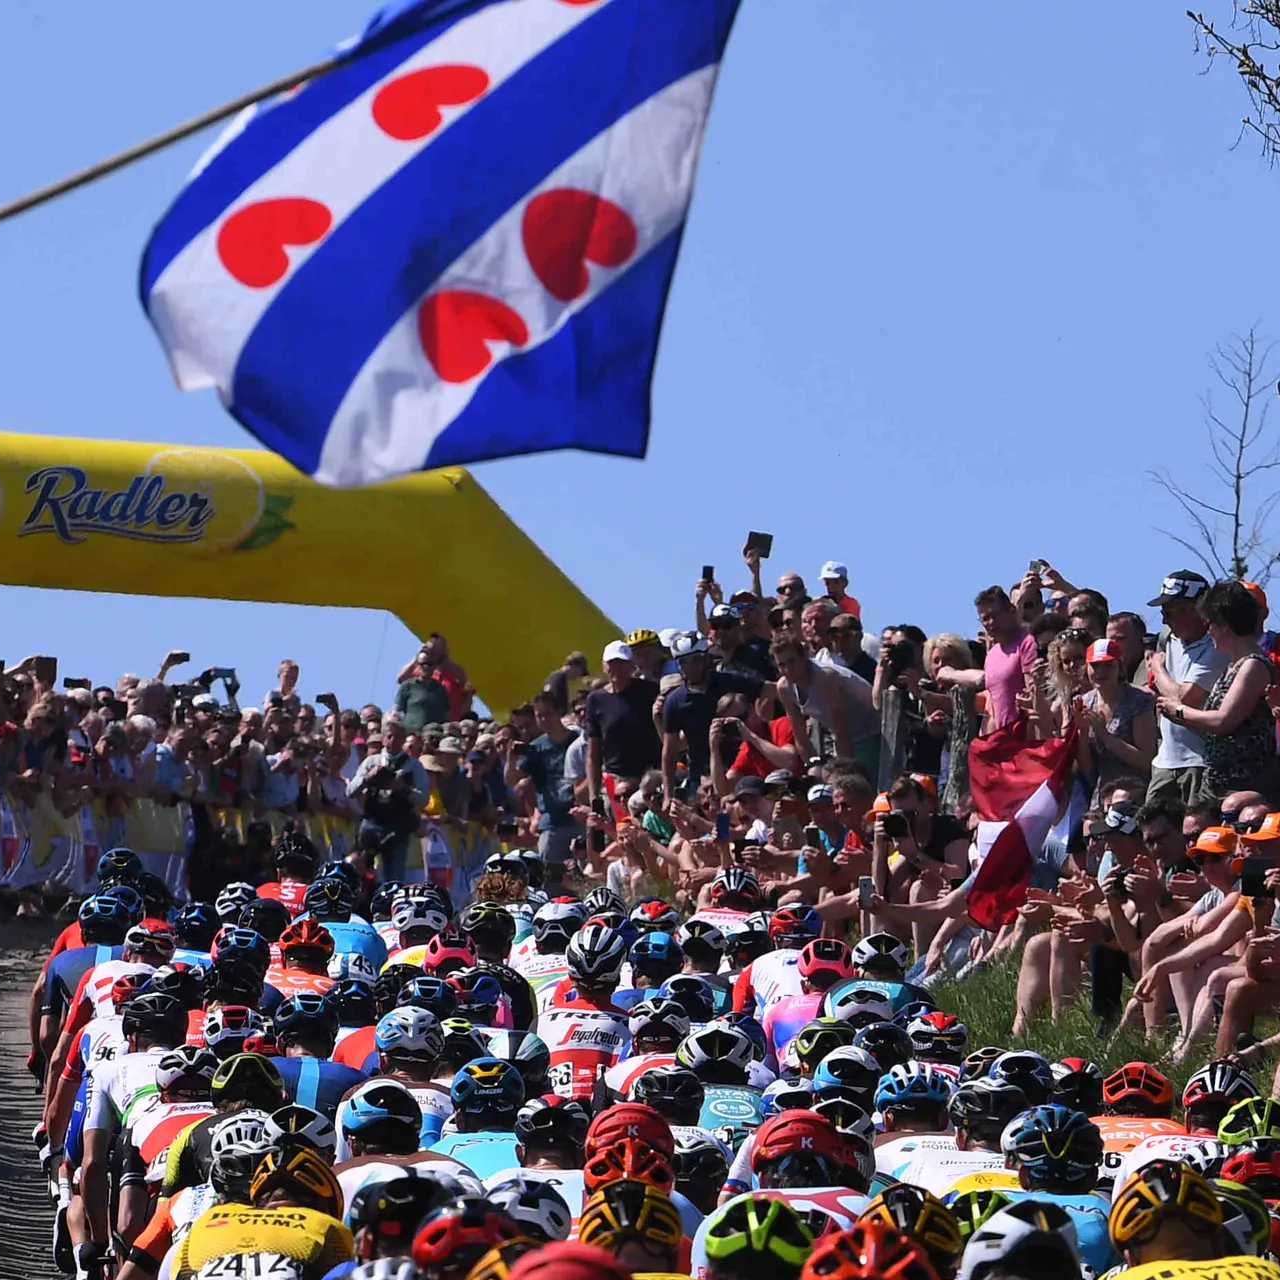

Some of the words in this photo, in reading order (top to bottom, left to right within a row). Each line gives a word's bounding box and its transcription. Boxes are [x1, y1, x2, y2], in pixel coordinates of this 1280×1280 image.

[17, 465, 215, 544] Radler
[505, 903, 534, 912] RA
[185, 1033, 204, 1041] sun
[556, 1023, 621, 1047] Segafredo
[94, 1046, 118, 1062] 96
[800, 1136, 814, 1149] K
[921, 1143, 958, 1151] MONDI
[238, 1218, 306, 1231] VISMA
[204, 1254, 246, 1278] 24
